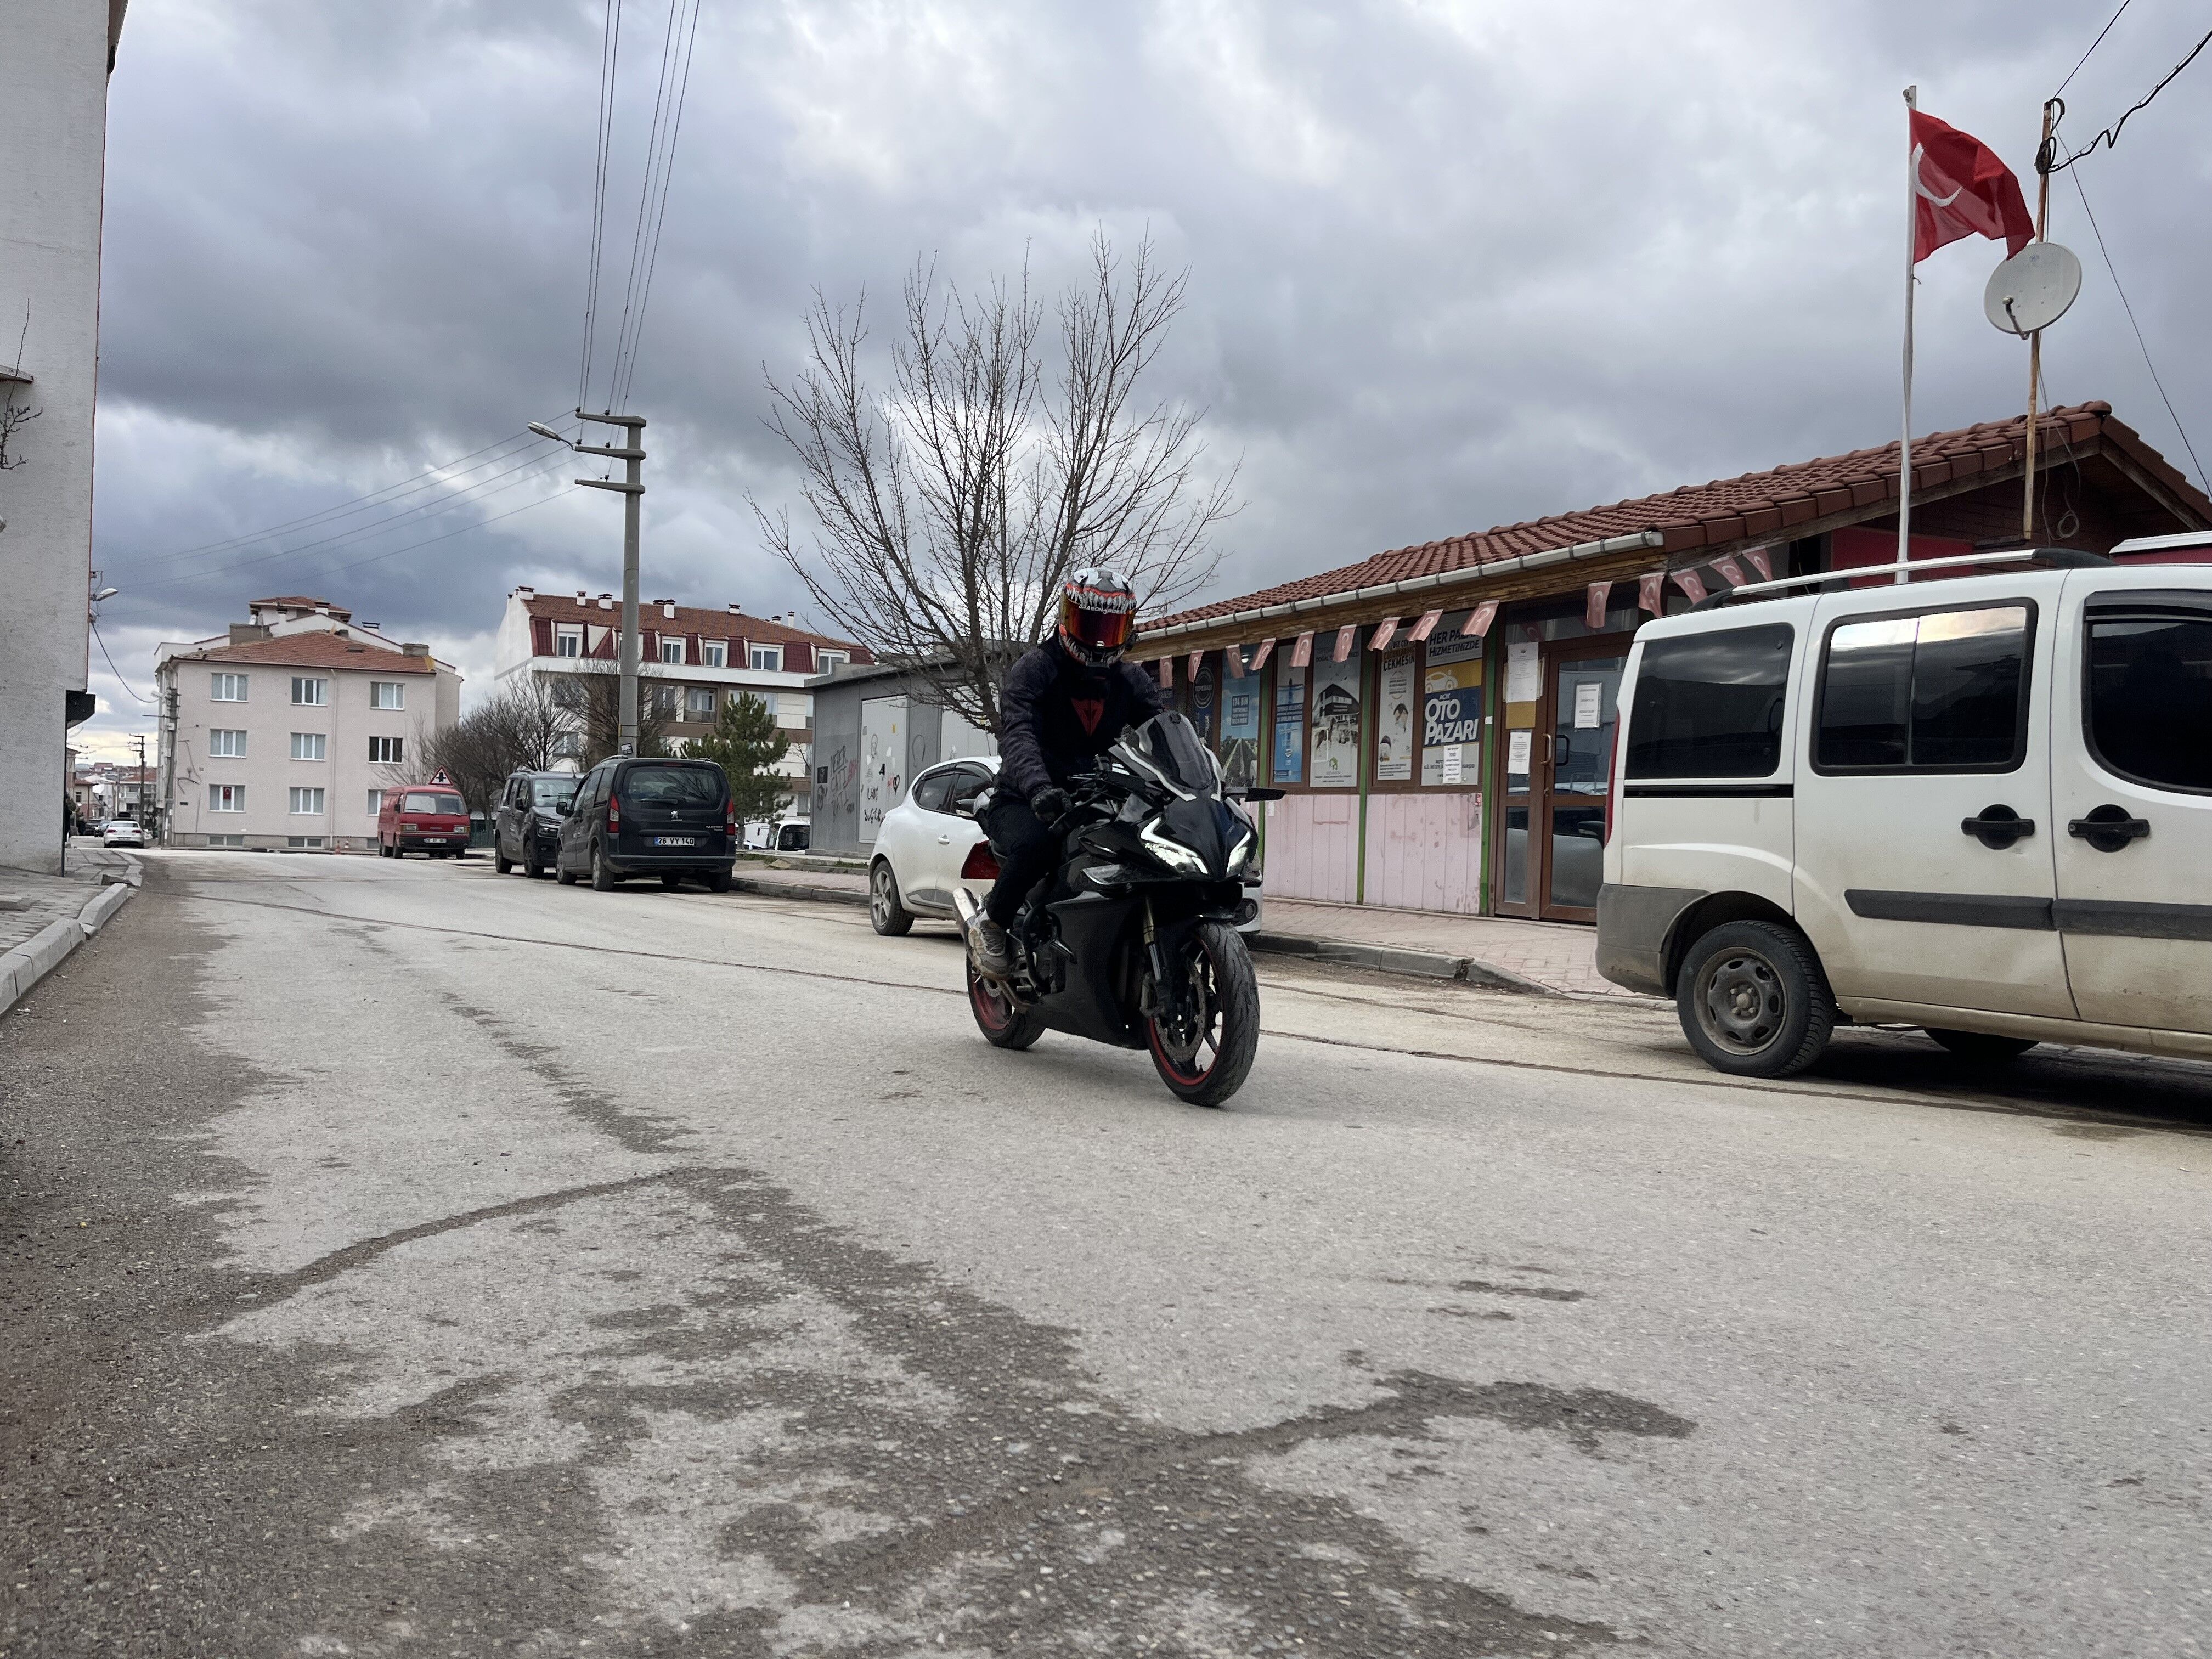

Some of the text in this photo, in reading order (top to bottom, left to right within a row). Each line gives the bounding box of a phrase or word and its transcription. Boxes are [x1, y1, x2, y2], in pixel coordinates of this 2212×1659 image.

[1430, 631, 1447, 645] HER
[1429, 639, 1480, 657] HİZMETİNİZDE
[1383, 655, 1415, 672] ÇEKMESİN
[1425, 698, 1460, 723] OTO
[1424, 719, 1479, 745] PAZARI
